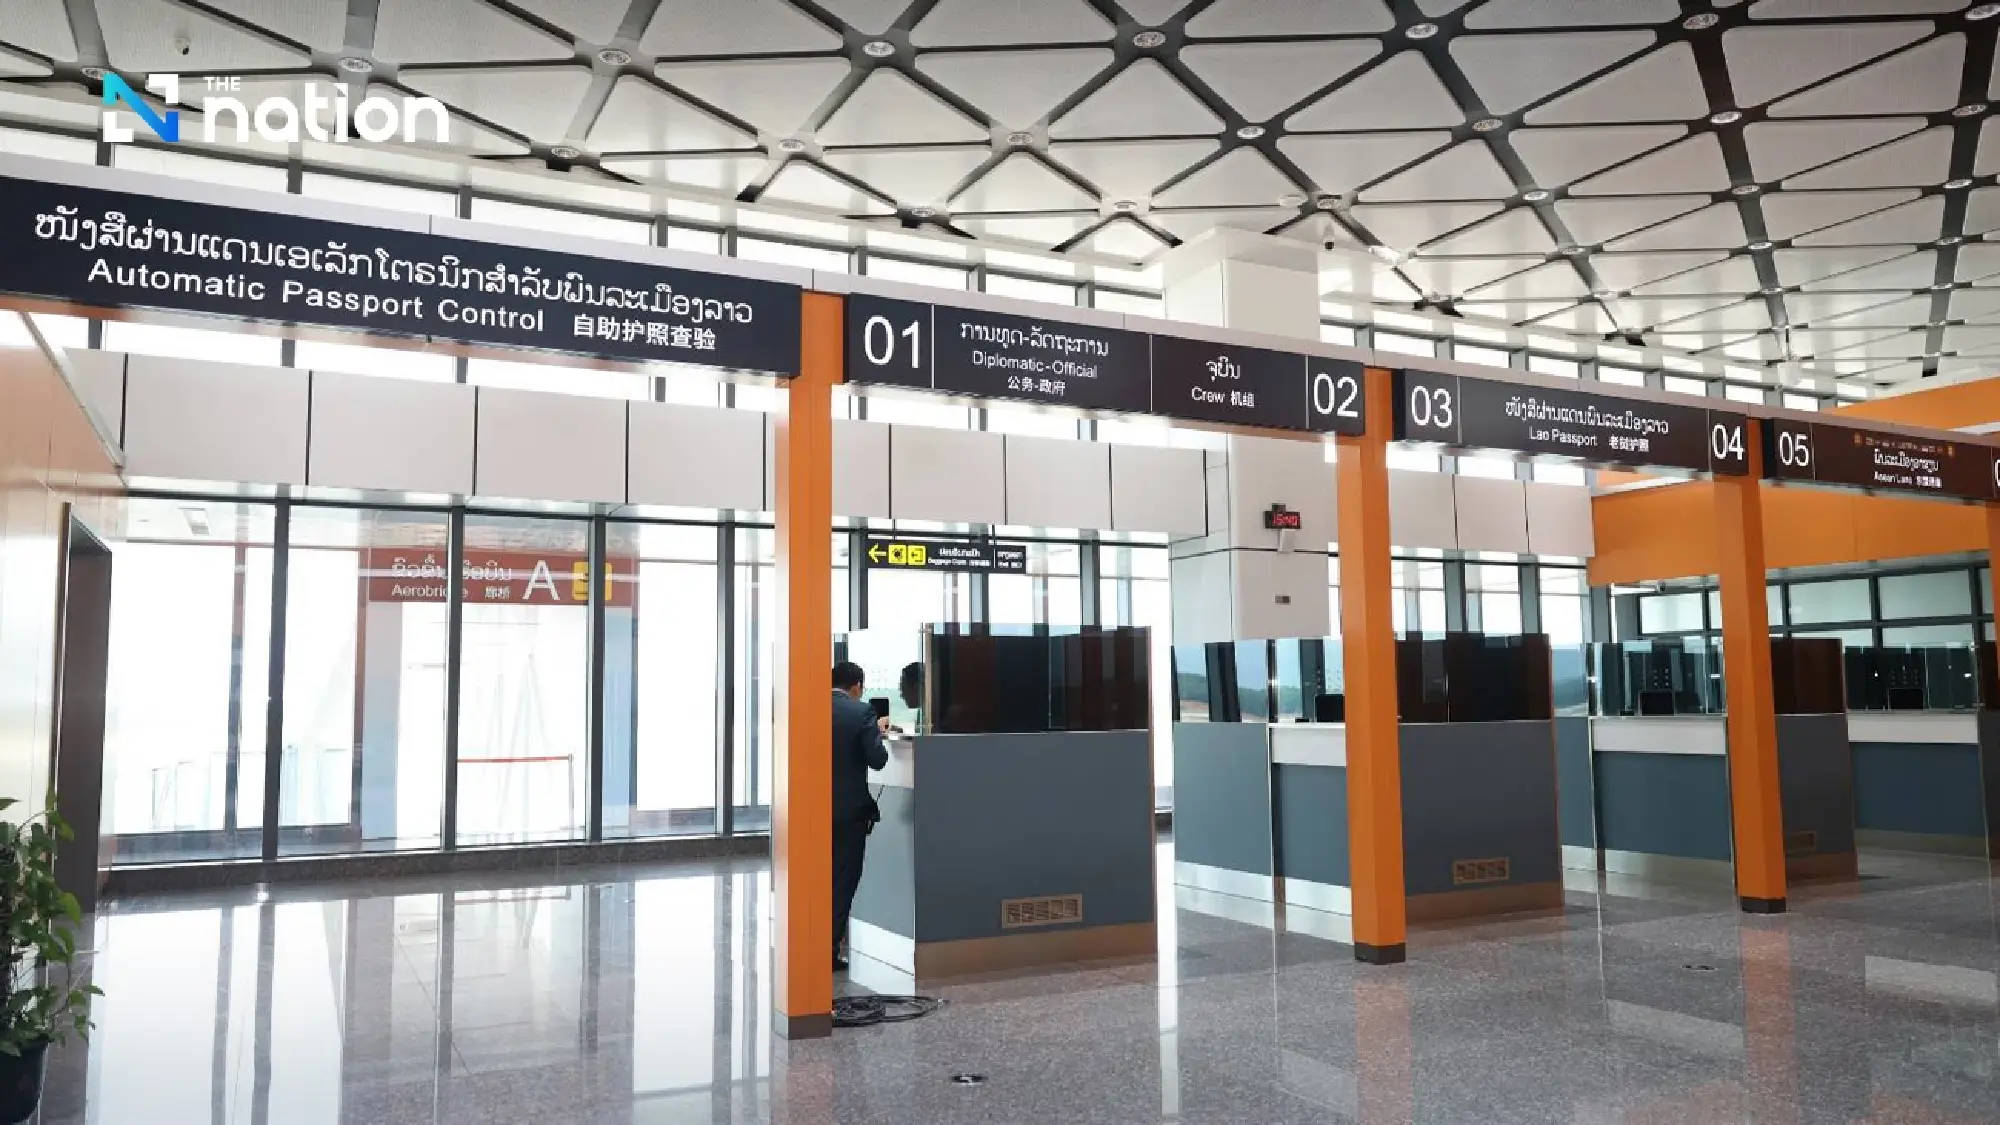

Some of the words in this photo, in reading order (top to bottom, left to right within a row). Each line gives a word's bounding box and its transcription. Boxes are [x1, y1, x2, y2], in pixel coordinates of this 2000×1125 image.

[88, 258, 266, 301] Automatic
[283, 279, 424, 318] Passport
[437, 299, 544, 332] Control
[573, 314, 716, 350] 自助护照查验
[864, 315, 921, 369] 01
[973, 351, 1098, 378] Diplomatic-Official
[1191, 386, 1225, 403] Crew
[1231, 391, 1255, 409] 机组
[1313, 372, 1358, 417] 02
[1411, 386, 1452, 428] 03
[1529, 426, 1550, 441] Lao
[1552, 429, 1598, 447] Passport
[1711, 423, 1744, 460] 04
[1779, 432, 1810, 466] 05
[392, 584, 469, 598] Aerobrie
[522, 560, 560, 600] A
